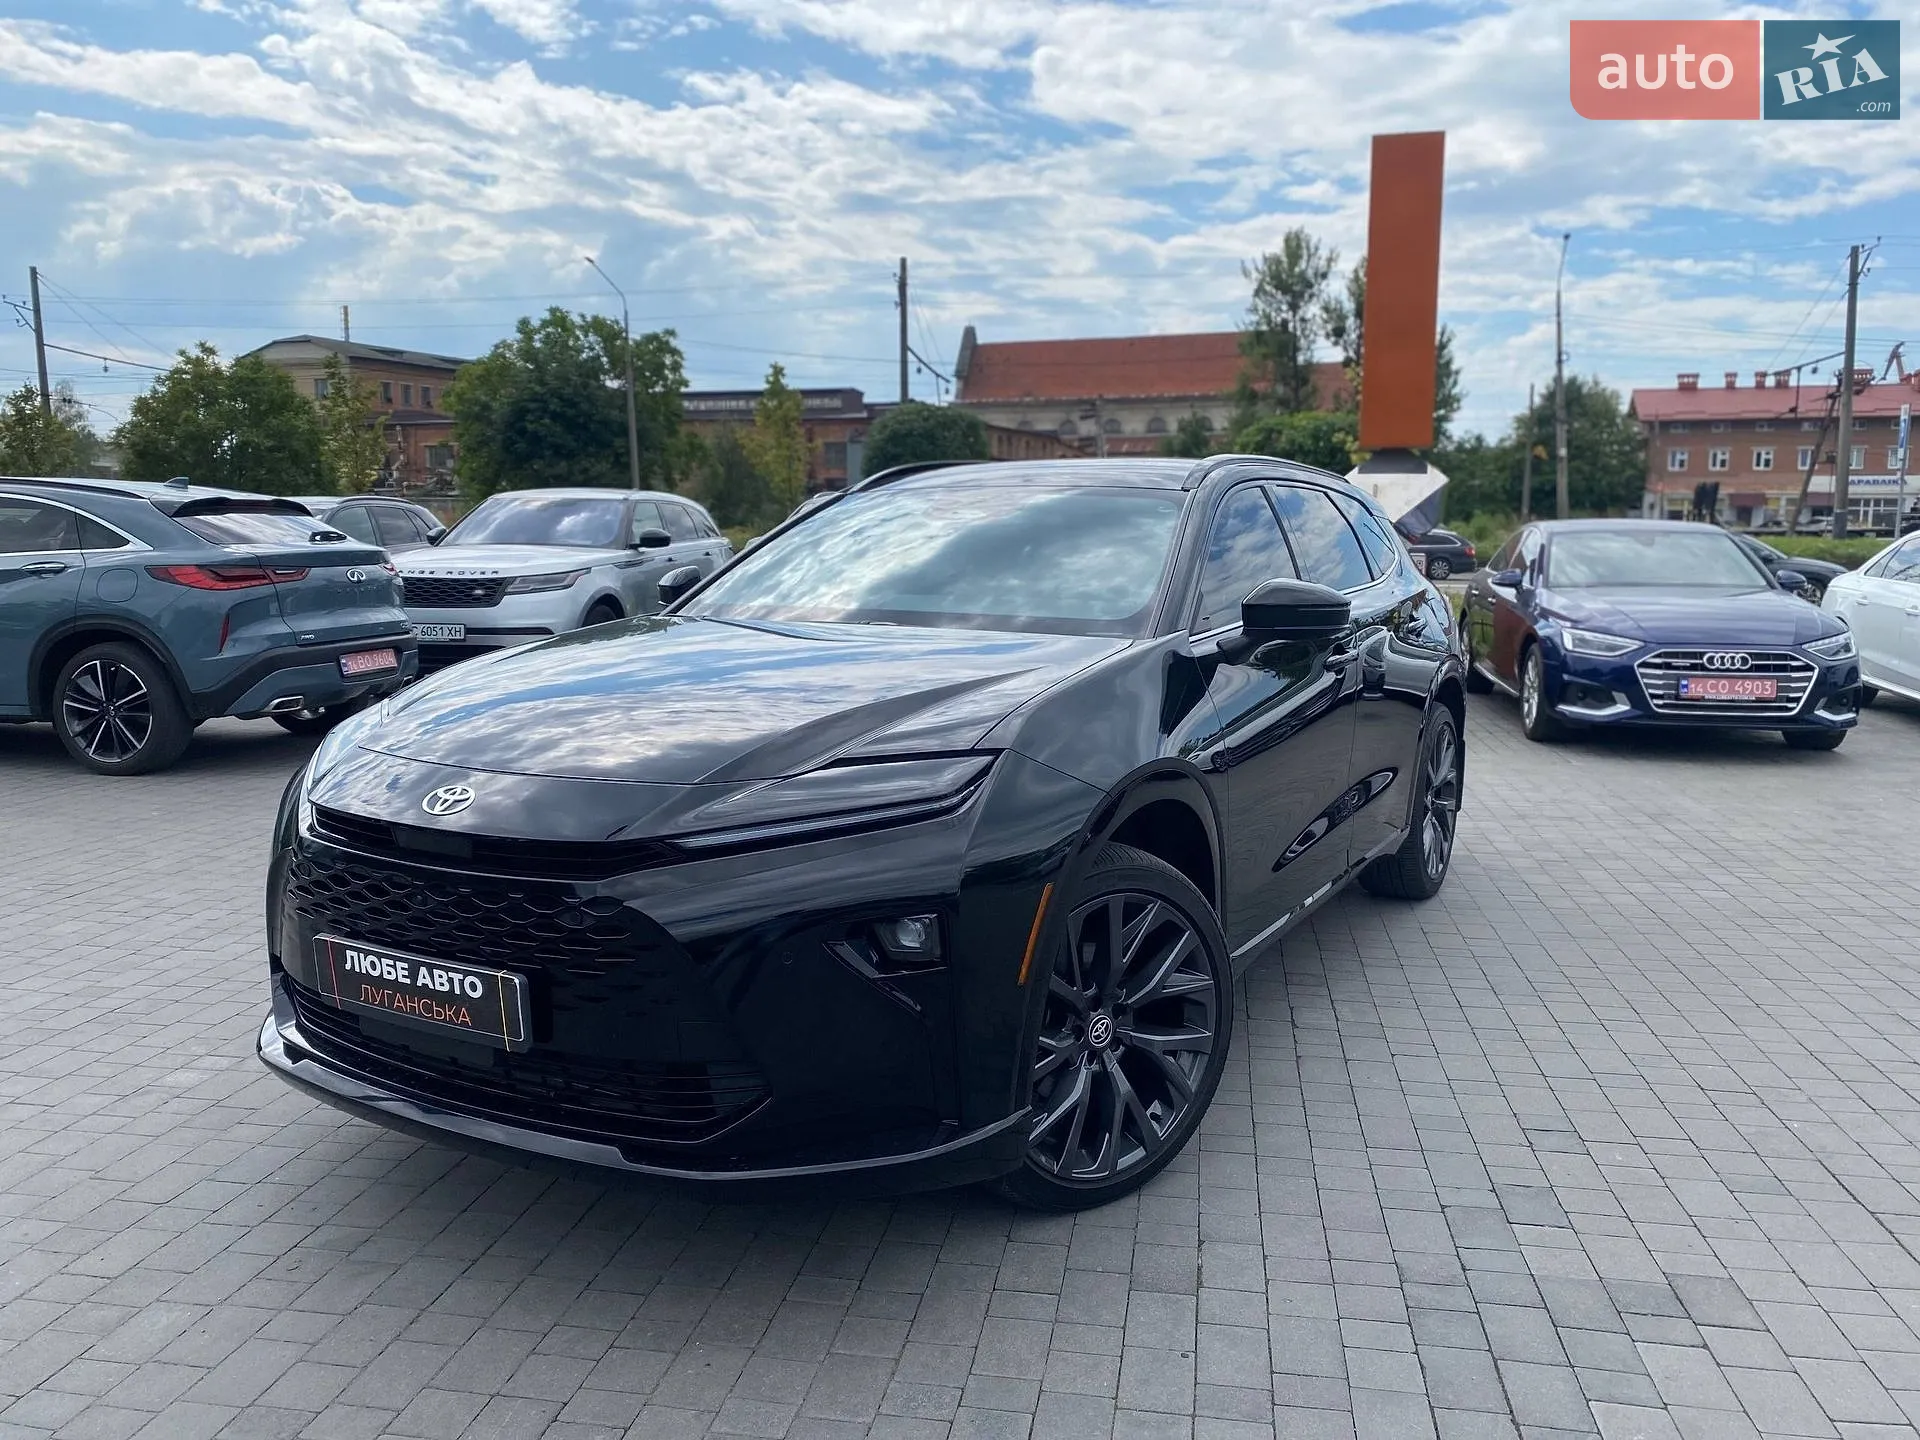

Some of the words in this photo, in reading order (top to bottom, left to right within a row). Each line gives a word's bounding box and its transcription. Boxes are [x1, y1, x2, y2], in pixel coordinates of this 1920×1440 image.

[420, 626, 444, 637] 6051
[447, 626, 462, 637] XH
[1707, 680, 1729, 693] CO
[1735, 680, 1772, 694] 4903
[345, 949, 411, 985] ЛЮБЕ
[416, 966, 483, 999] АВТО
[360, 984, 473, 1027] ЛУГАНСЬКА
